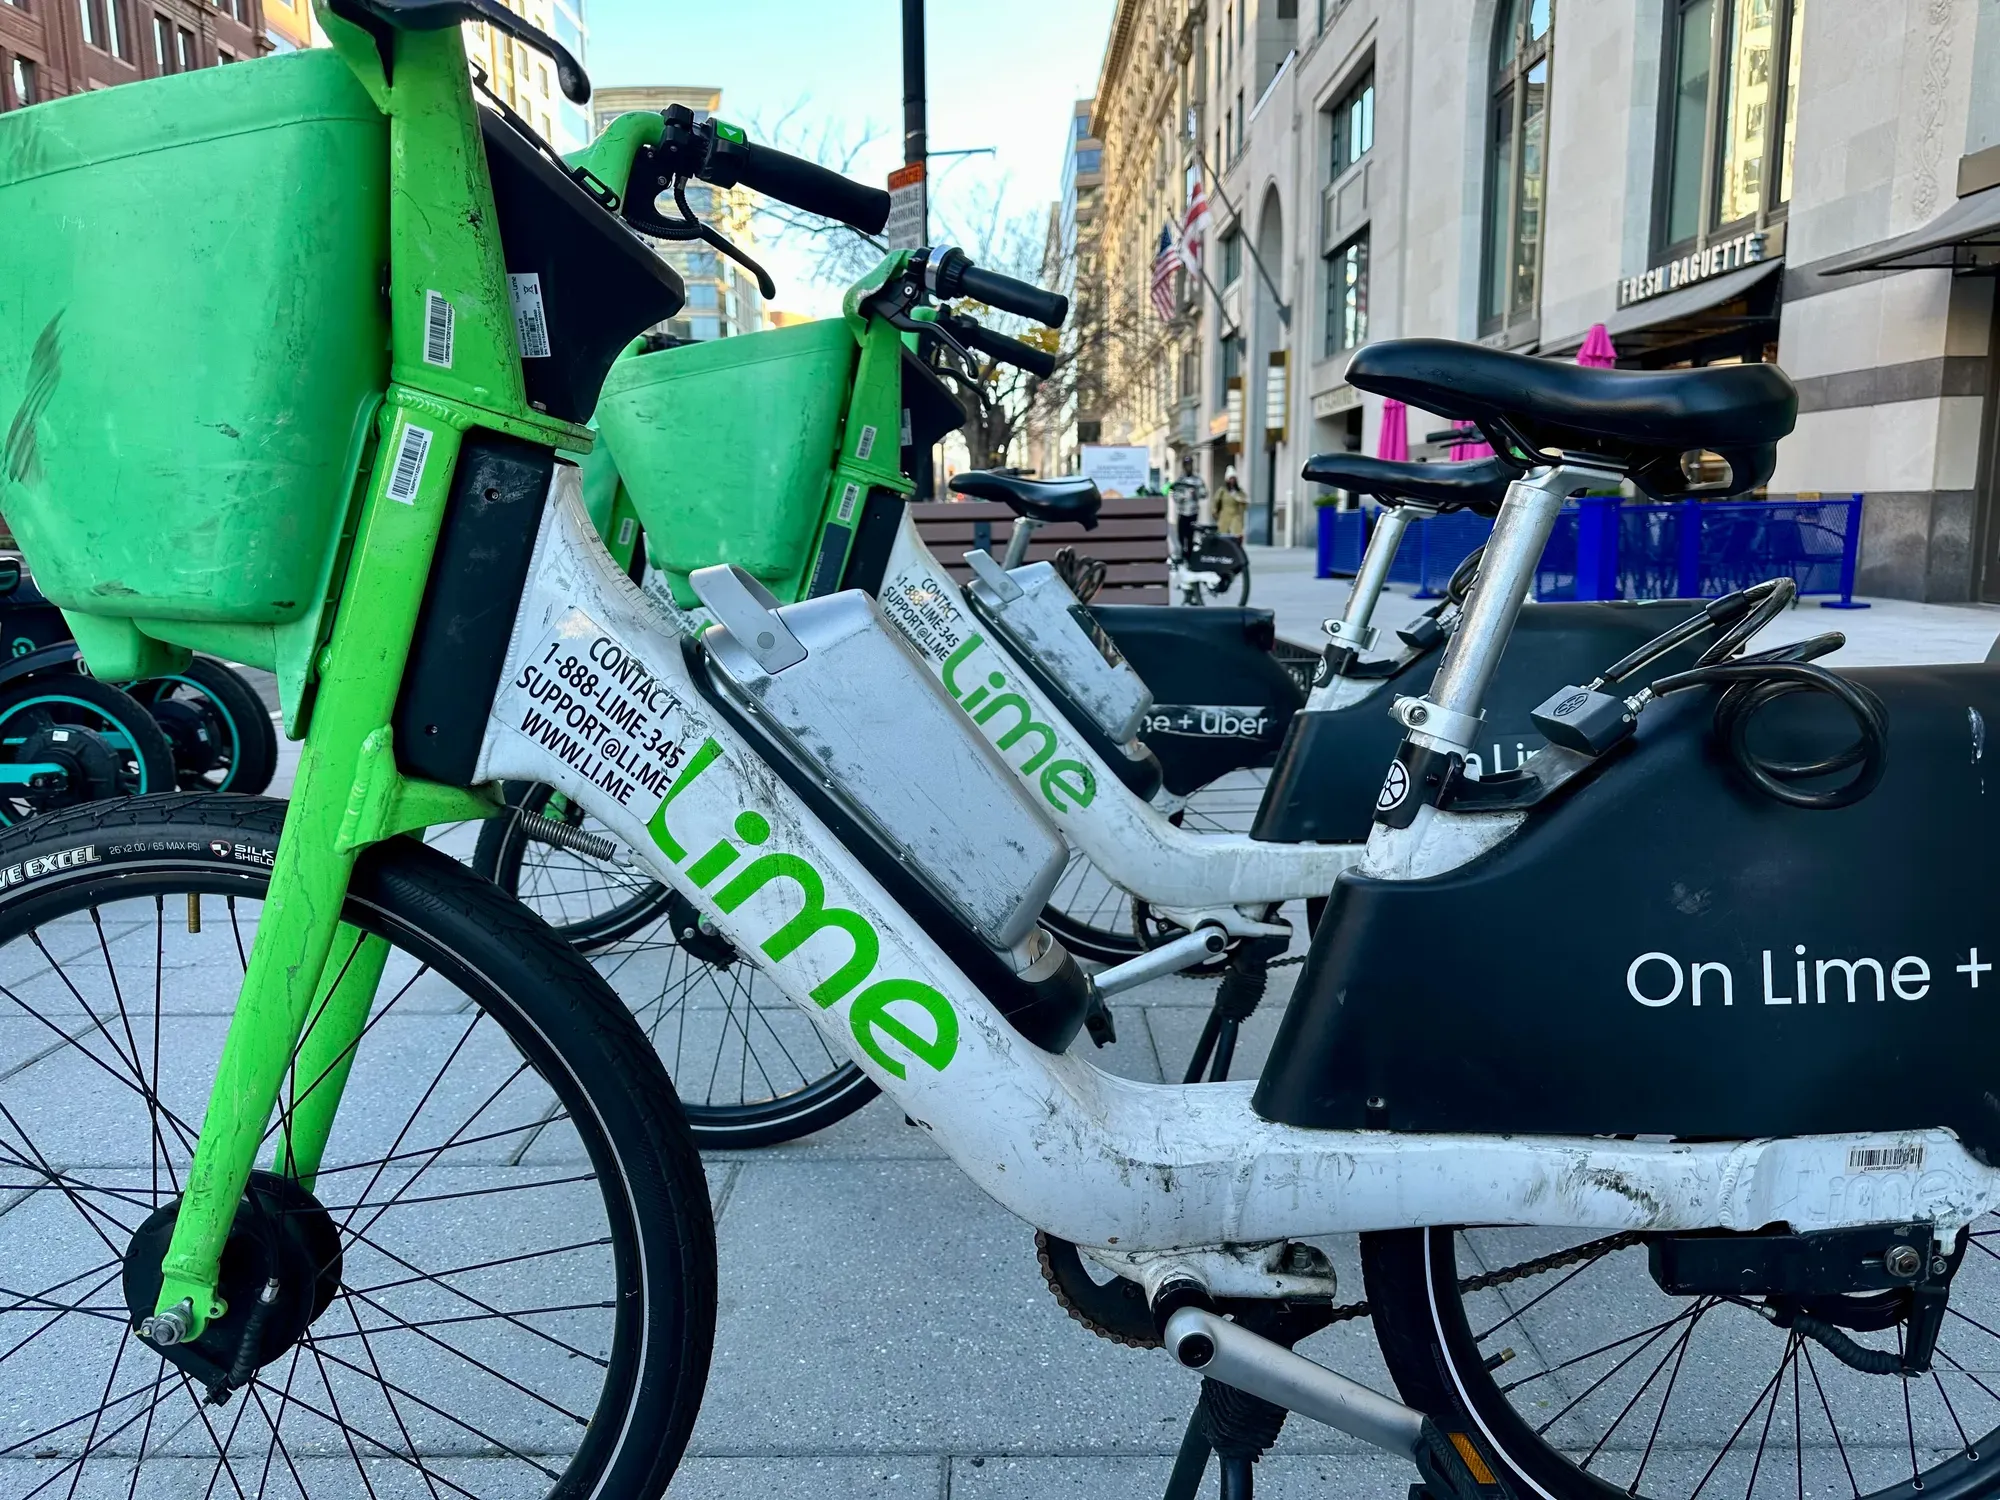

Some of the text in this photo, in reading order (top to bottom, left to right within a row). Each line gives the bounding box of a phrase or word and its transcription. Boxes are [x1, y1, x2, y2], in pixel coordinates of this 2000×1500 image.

[1621, 232, 1757, 305] FRESH BAGUETTE
[883, 586, 950, 661] SUPPORT@LI.ME
[898, 577, 960, 648] 1-888-LIME-345
[921, 578, 962, 623] CONTACT
[543, 642, 686, 769] 1-888-LIME-345
[589, 637, 682, 720] CONTACT
[515, 665, 673, 800] SUPPORT@LI.ME
[520, 707, 635, 806] WWW.LI.ME
[942, 632, 1097, 814] Lime
[1178, 714, 1194, 730] +
[1200, 711, 1268, 735] Uber
[24, 844, 101, 879] EXCEL
[152, 841, 165, 851] 65
[166, 841, 186, 851] MAX
[187, 841, 201, 852] PSI
[234, 843, 274, 858] SILK
[234, 852, 275, 867] SHIELD
[646, 737, 959, 1081] Lime
[1626, 944, 1992, 1007] On Lime +
